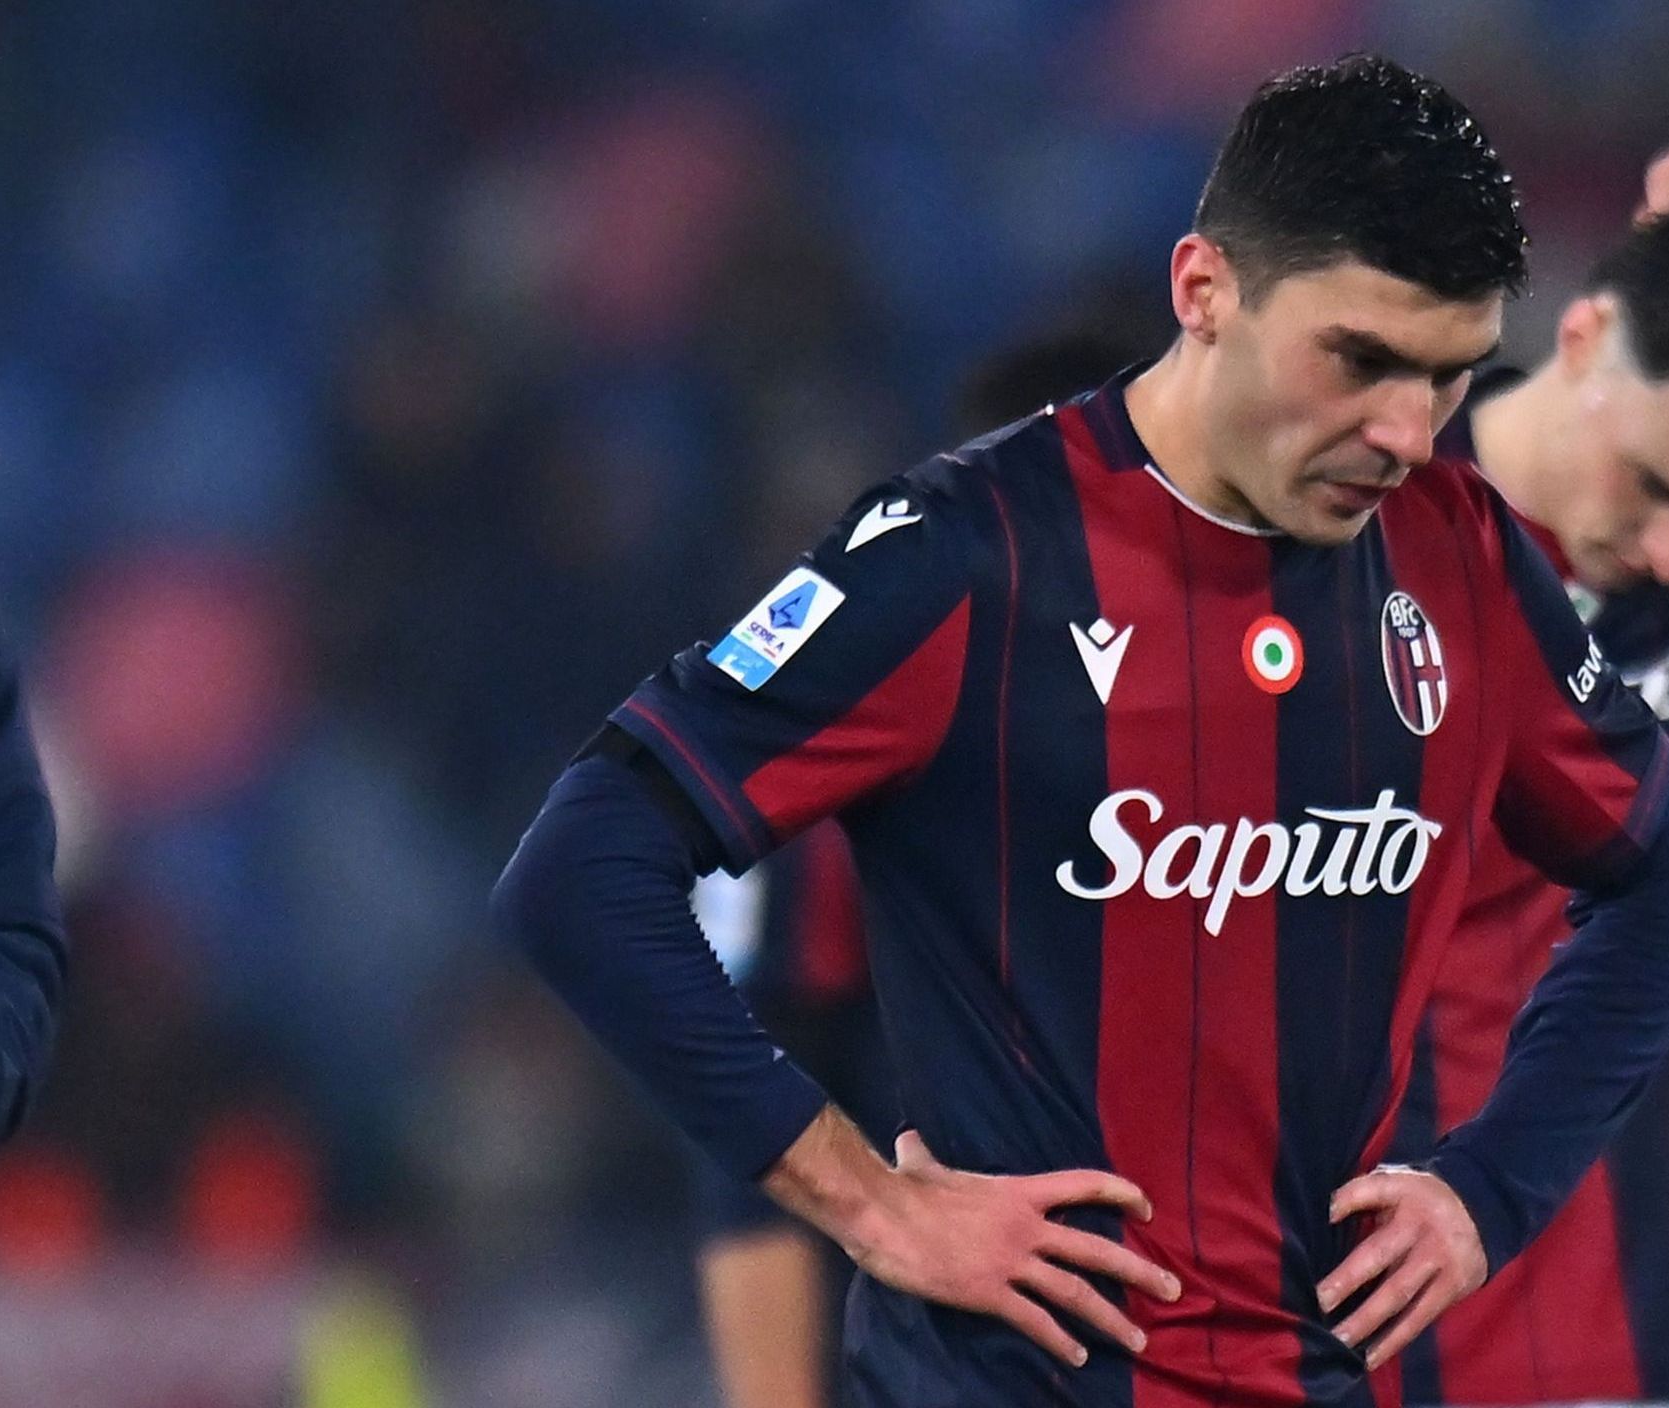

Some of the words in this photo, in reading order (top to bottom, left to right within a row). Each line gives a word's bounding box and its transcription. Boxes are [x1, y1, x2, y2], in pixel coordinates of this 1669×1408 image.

[1388, 597, 1419, 627] BFC
[1566, 633, 1603, 704] Lav
[1055, 789, 1443, 937] Saputo
